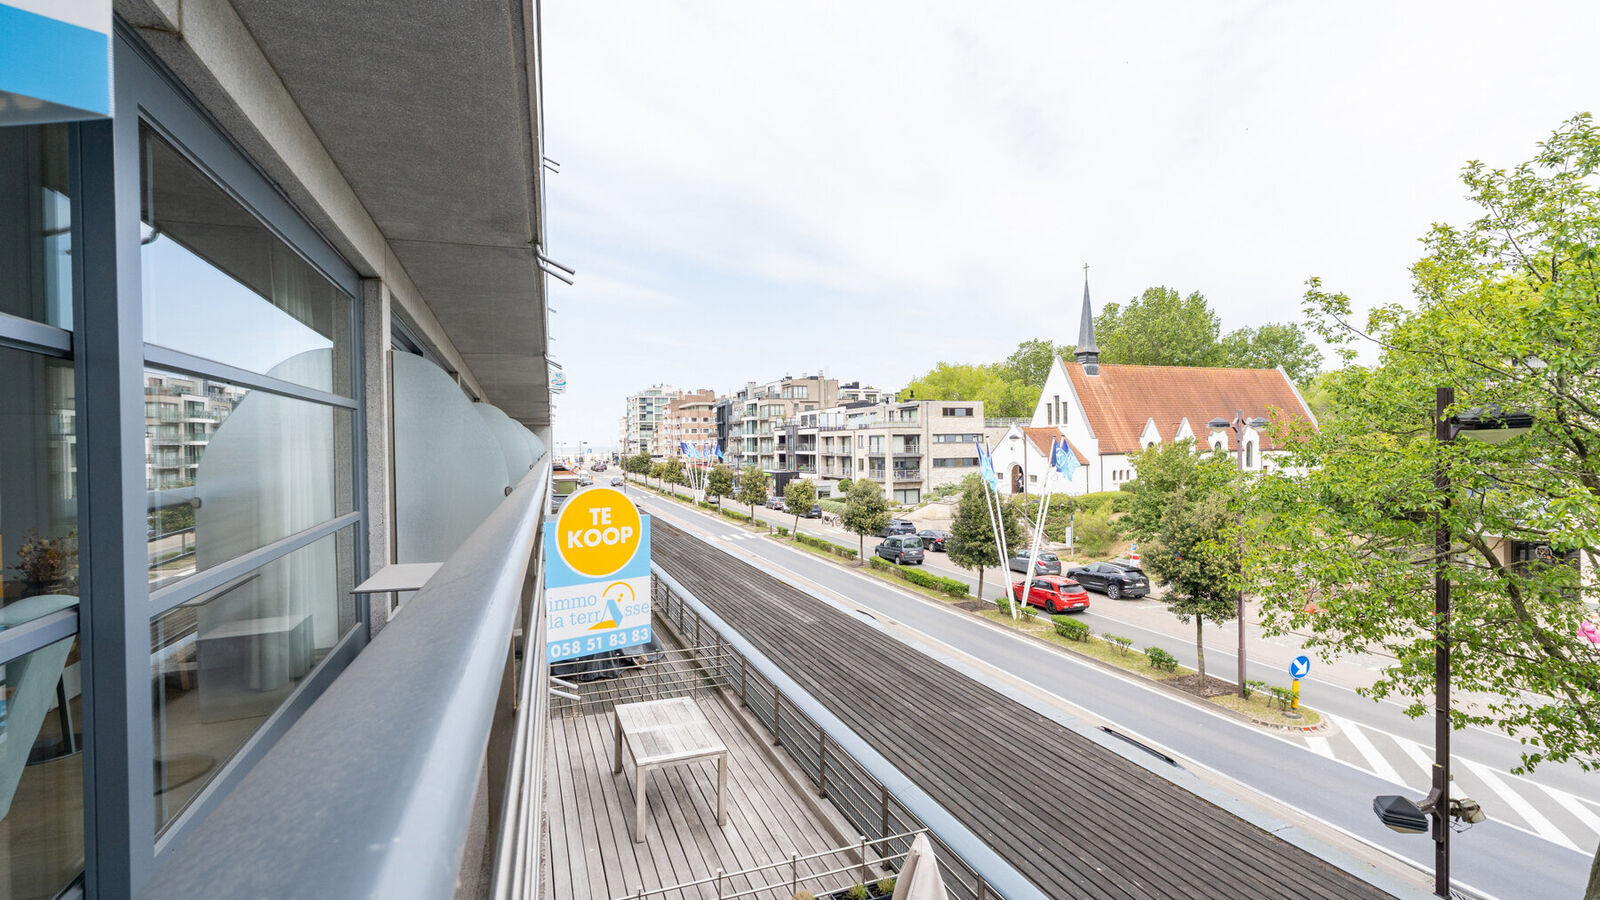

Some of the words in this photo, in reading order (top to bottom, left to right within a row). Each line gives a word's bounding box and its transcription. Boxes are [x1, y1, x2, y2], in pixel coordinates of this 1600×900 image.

[589, 507, 612, 526] TE
[567, 526, 633, 549] KOOP
[549, 594, 597, 612] immo
[549, 614, 564, 630] la
[550, 640, 581, 658] 058
[586, 637, 602, 651] 51
[609, 632, 627, 647] 83
[631, 627, 649, 643] 83
